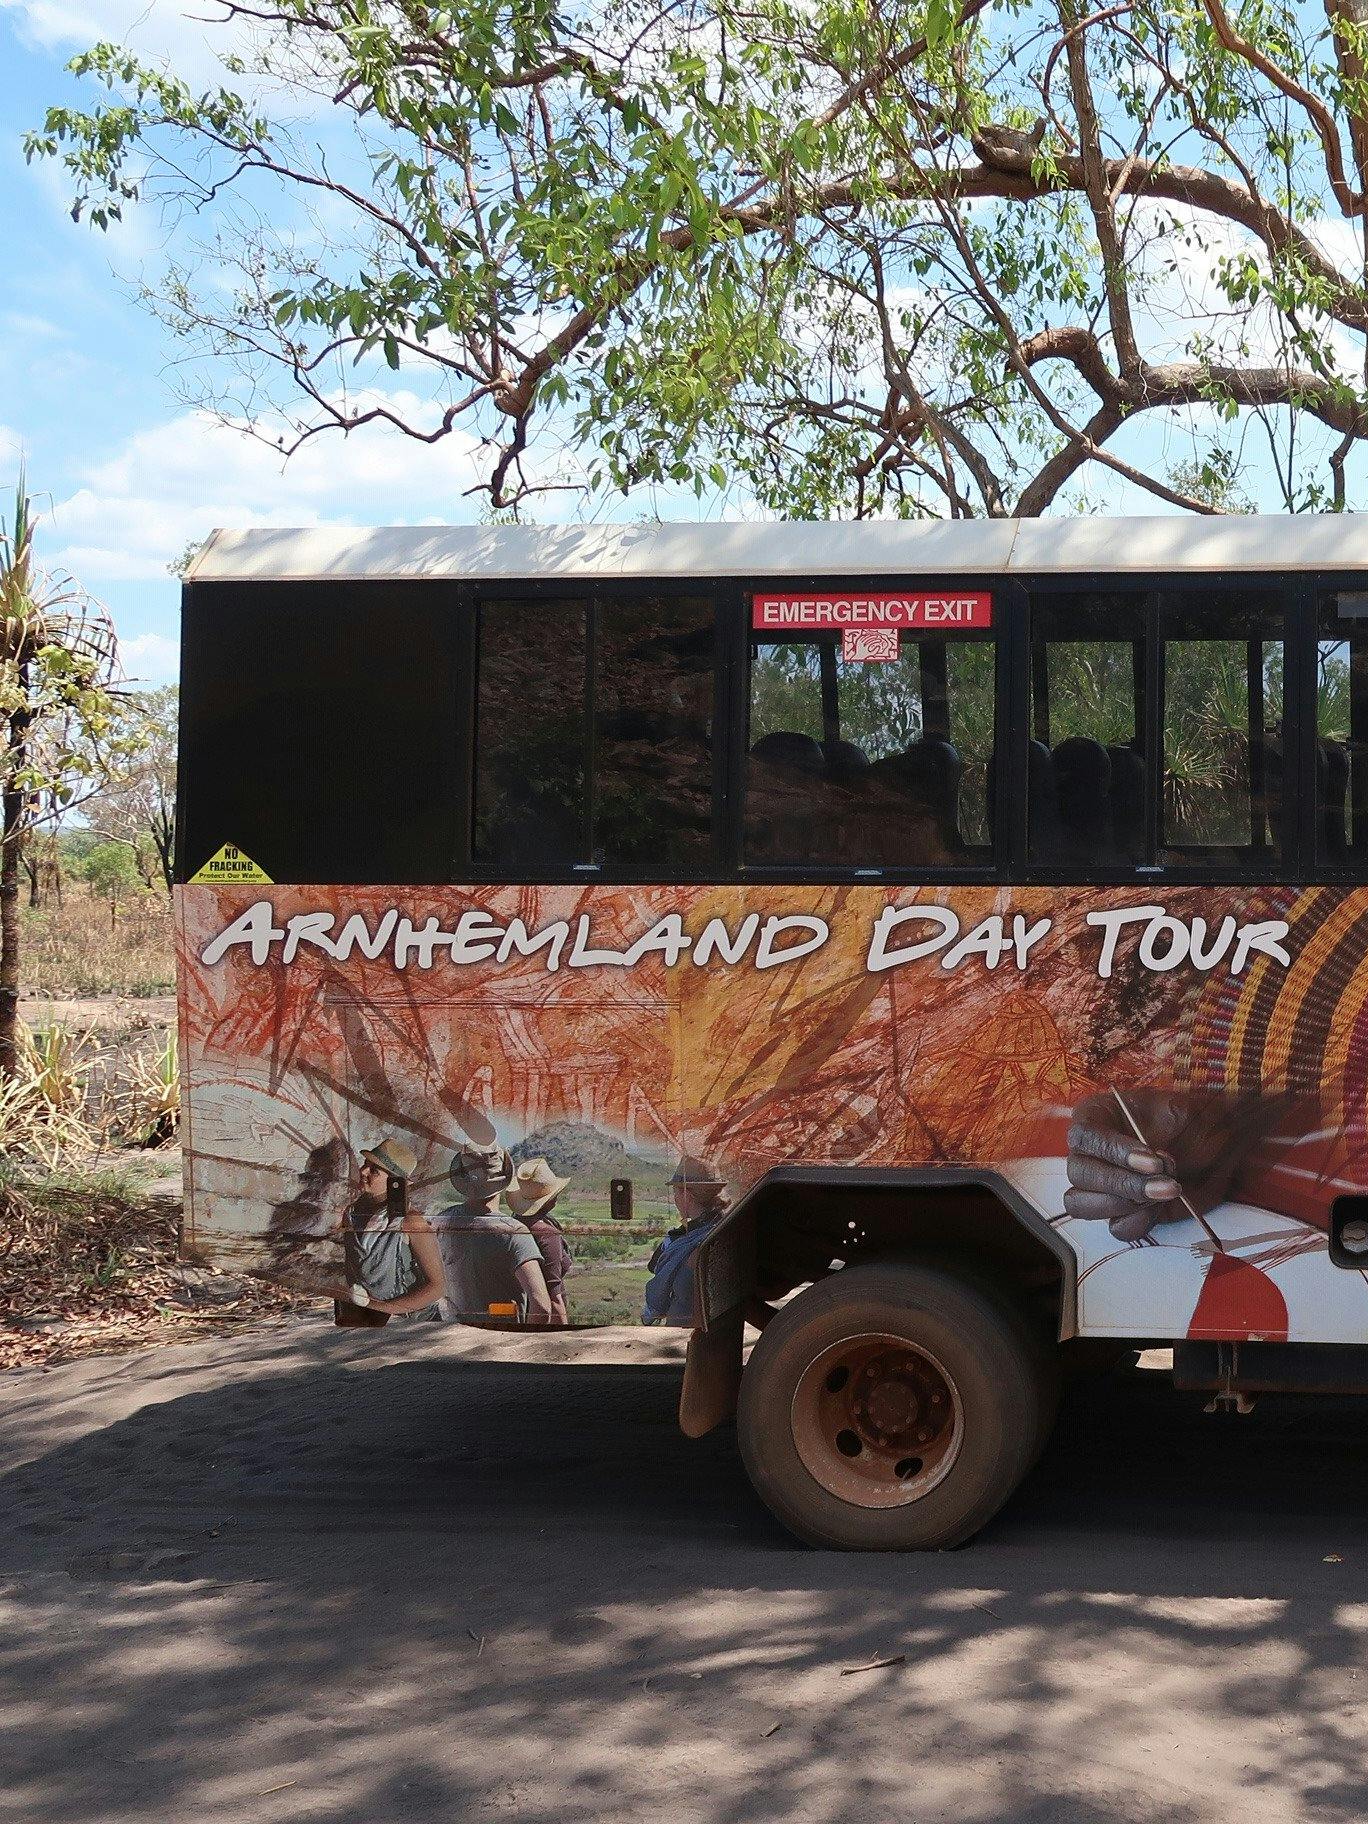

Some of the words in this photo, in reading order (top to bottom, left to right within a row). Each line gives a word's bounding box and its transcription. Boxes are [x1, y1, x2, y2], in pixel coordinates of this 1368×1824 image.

[763, 600, 920, 623] EMERGENCY
[924, 600, 978, 621] EXIT
[224, 848, 239, 860] NO
[209, 861, 253, 871] FRACKING
[201, 901, 830, 971] ARNHEMLAND
[867, 904, 1052, 972] DAY
[1087, 905, 1291, 978] TOUR
